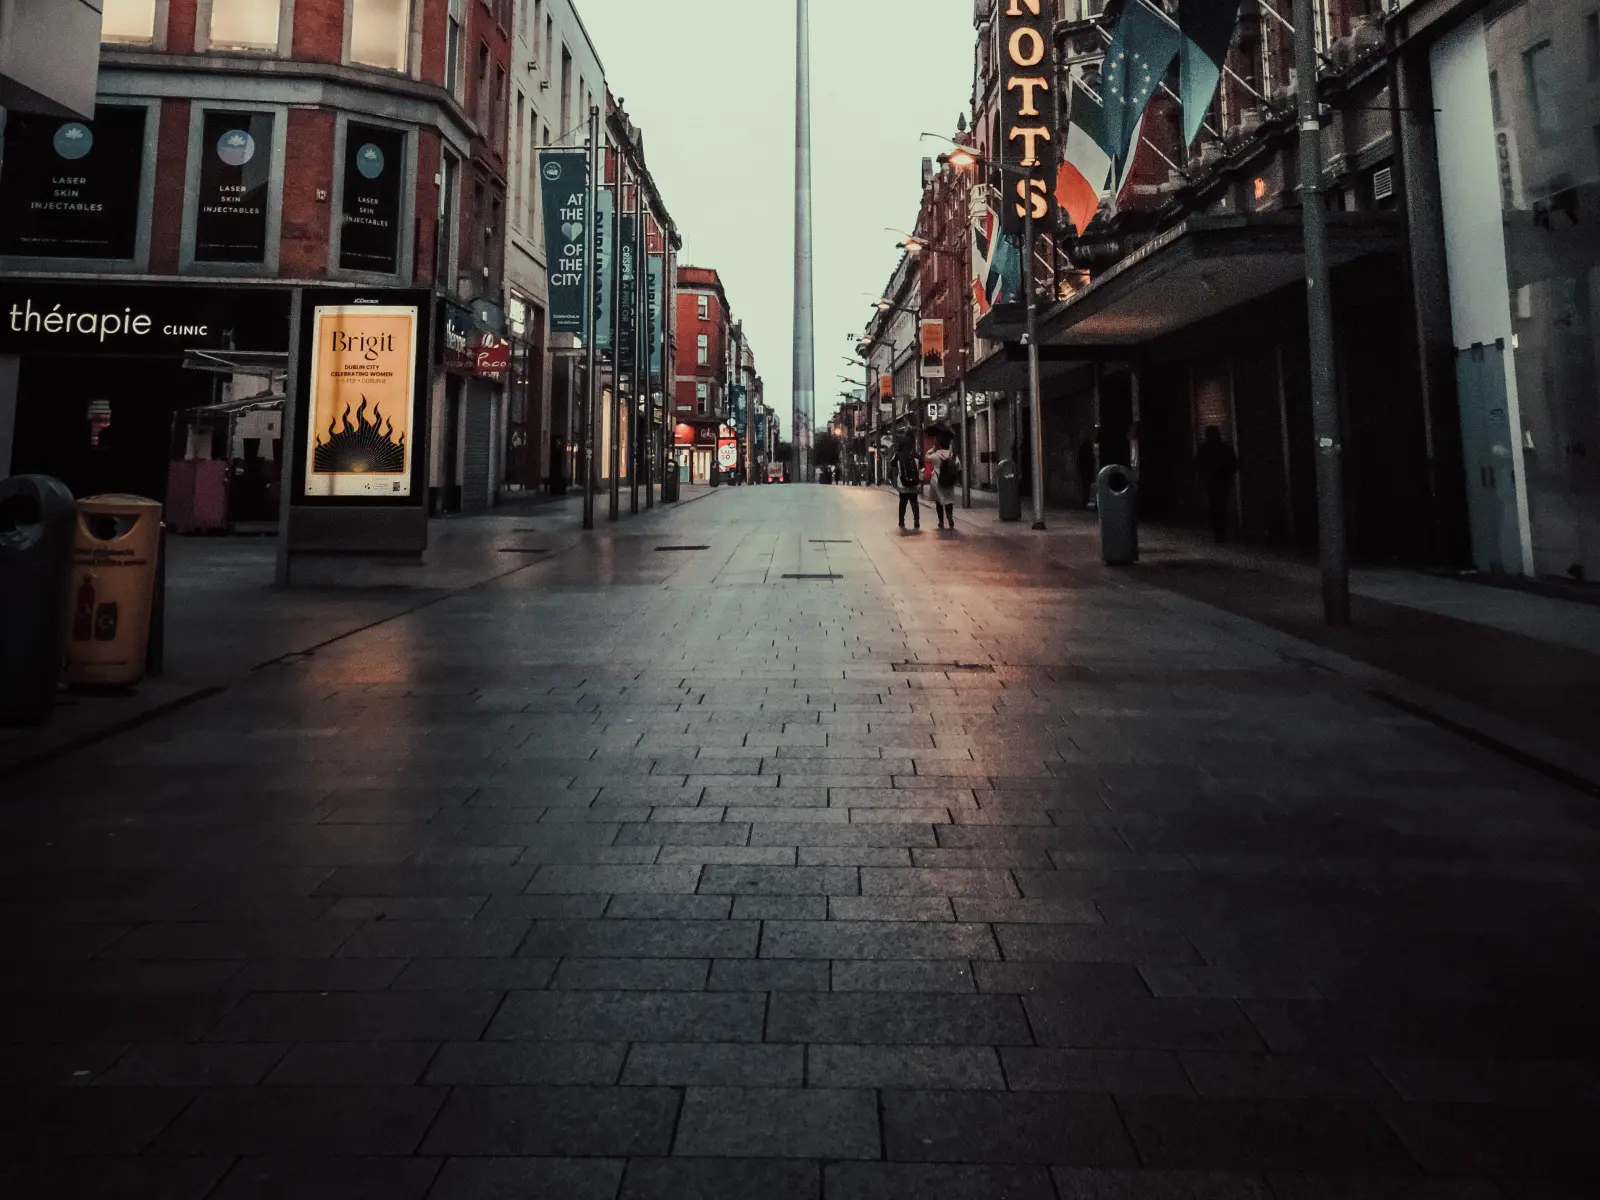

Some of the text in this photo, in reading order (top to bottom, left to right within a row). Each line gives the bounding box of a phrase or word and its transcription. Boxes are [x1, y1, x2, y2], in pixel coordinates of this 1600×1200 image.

[52, 177, 87, 185] LASER
[54, 189, 79, 197] SKIN
[357, 196, 379, 205] LASER
[566, 193, 584, 206] AT
[30, 202, 103, 211] INJECTABLES
[203, 206, 260, 214] INJECTABLES
[560, 208, 584, 220] THE
[345, 215, 389, 227] INJECTABLES
[563, 244, 583, 256] OF
[558, 258, 583, 271] THE
[550, 273, 582, 286] CITY
[9, 299, 208, 342] thérapie CLINIC
[332, 331, 396, 361] Brigit
[477, 352, 507, 367] Paco
